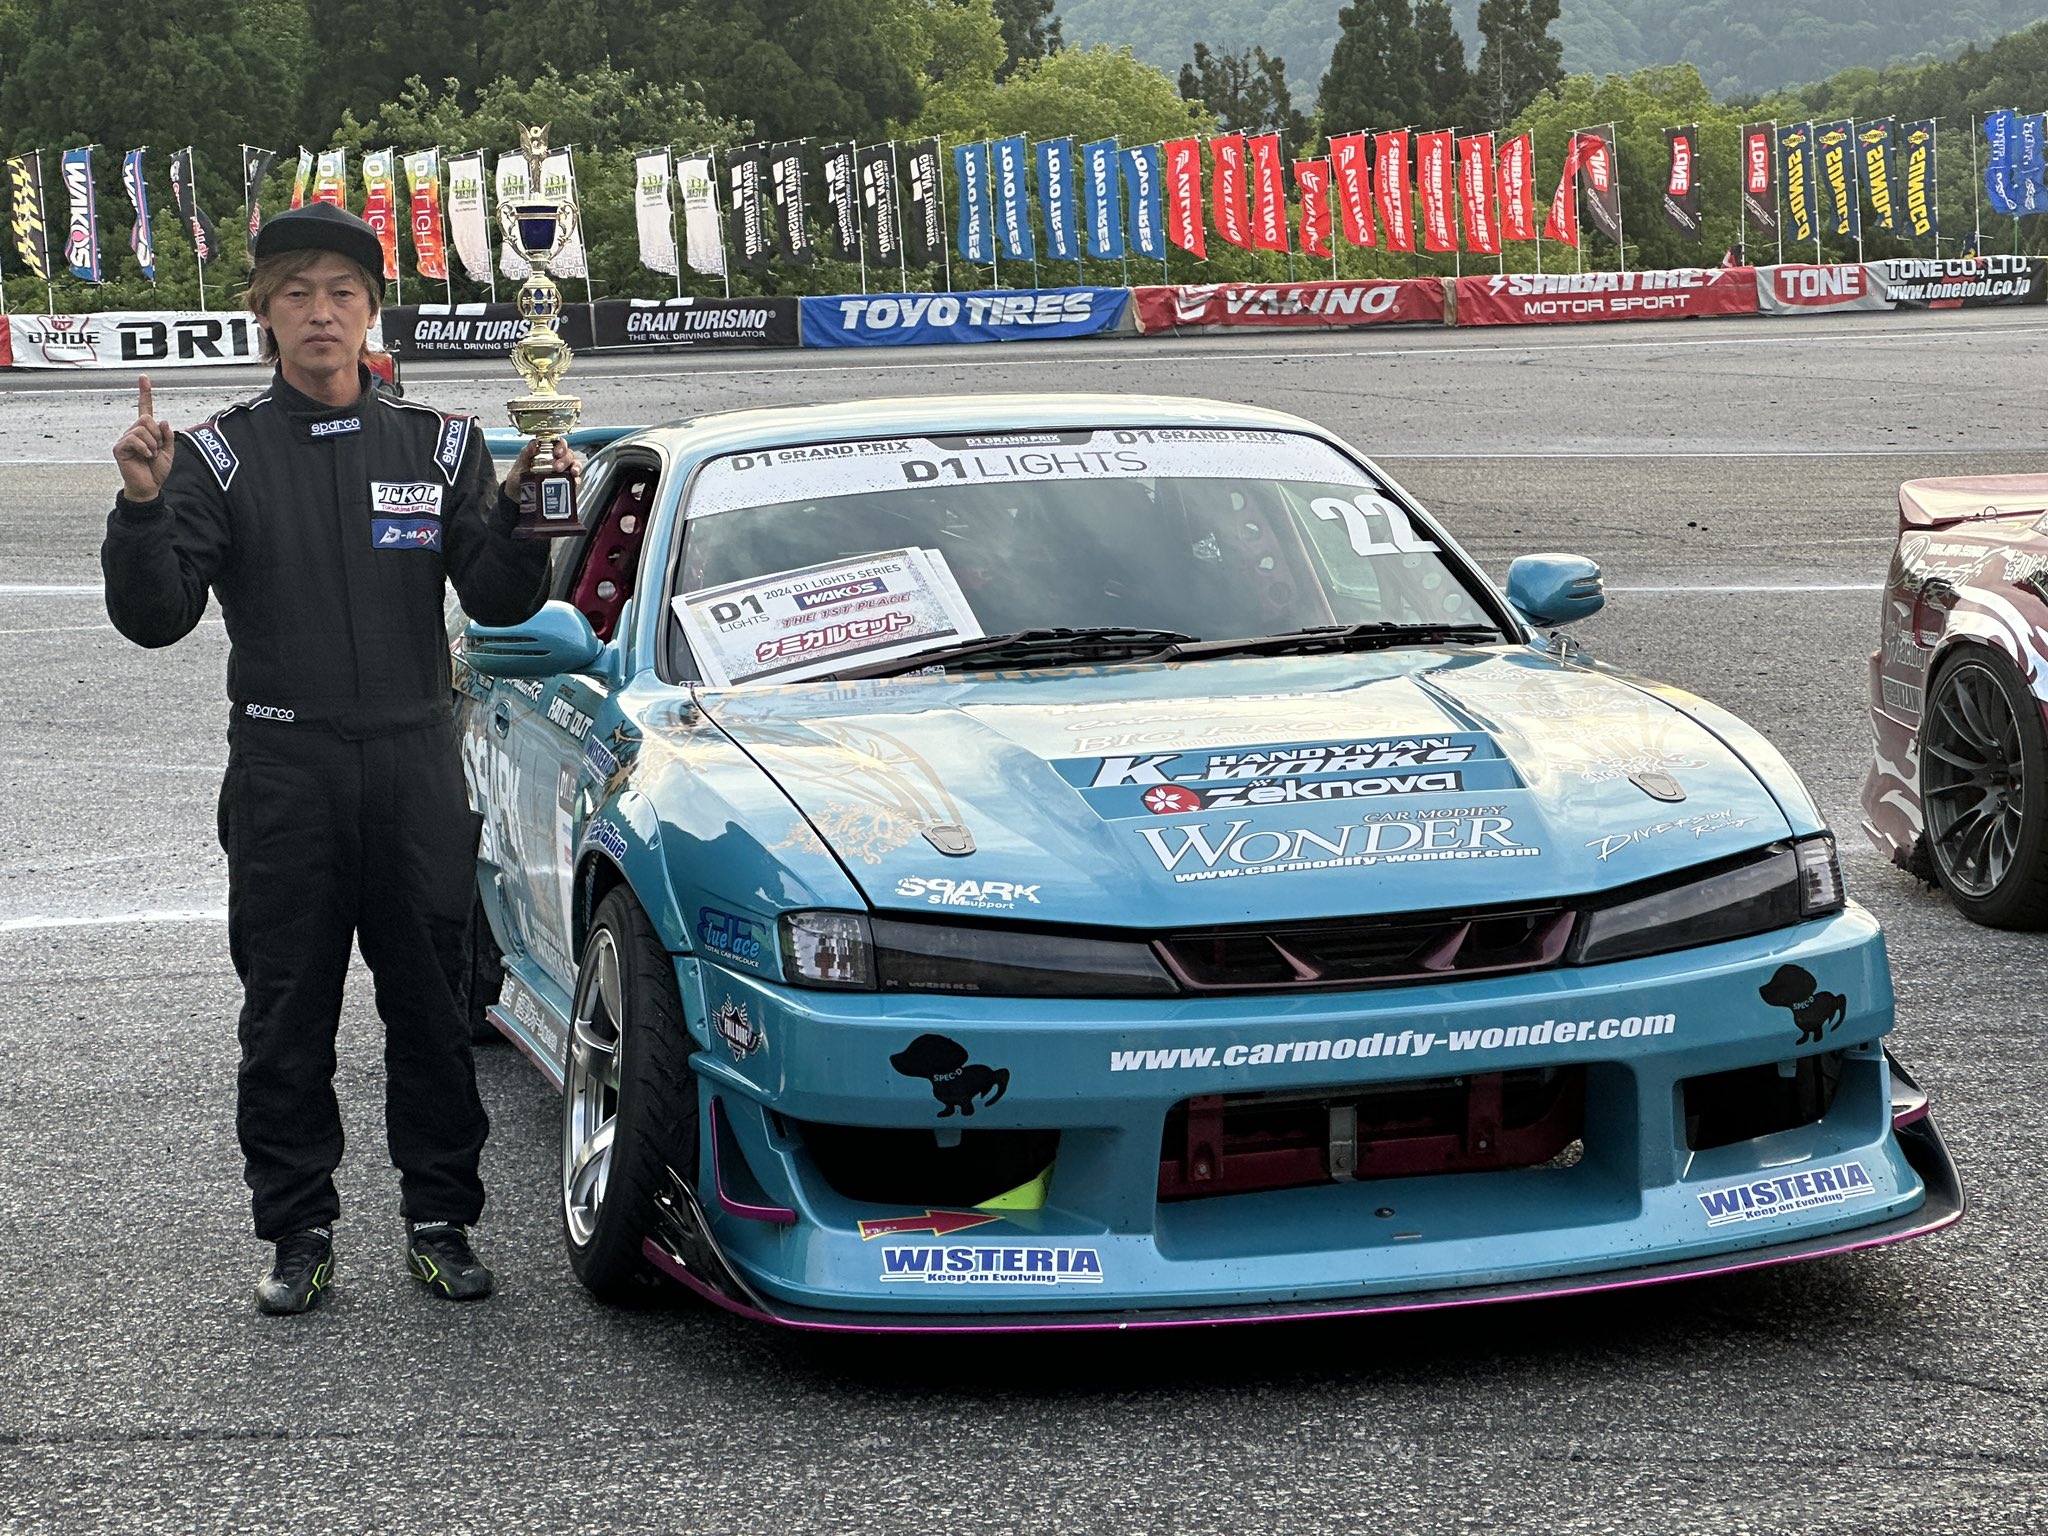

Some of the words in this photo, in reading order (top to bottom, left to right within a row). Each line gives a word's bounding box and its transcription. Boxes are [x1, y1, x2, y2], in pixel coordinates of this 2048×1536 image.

[1381, 155, 1389, 193] MOTOR
[1223, 170, 1242, 241] VALINO
[1388, 147, 1405, 242] SHIBATIRE
[1431, 147, 1448, 242] SHIBATIRE
[1471, 151, 1489, 243] SHIBATIRE
[64, 162, 91, 268] WAKO'S
[1781, 266, 1860, 299] TONE
[1886, 260, 1944, 280] TONE
[1885, 277, 2031, 301] www.tonetool.co.jp
[840, 297, 962, 330] TOYO
[966, 293, 1093, 326] TIRES
[1524, 299, 1604, 315] MOTOR
[1610, 294, 1690, 312] SPORT
[414, 320, 470, 341] GRAN
[475, 320, 560, 341] TURISO
[627, 312, 680, 332] GRAN
[684, 309, 767, 331] TURISMO
[673, 331, 710, 340] DRIVING
[712, 330, 766, 338] SIMULATOR
[28, 331, 101, 344] BRIDE
[116, 318, 261, 361] BRI
[416, 342, 435, 350] THE
[437, 342, 462, 350] REAL
[464, 342, 501, 350] DRIVING
[311, 417, 360, 433] sparco
[1113, 431, 1155, 444] D1
[1158, 430, 1230, 440] GRAND
[1232, 432, 1283, 441] PRIX
[198, 428, 231, 469] sparco
[442, 420, 460, 464] sparco
[732, 453, 773, 471] D1
[778, 445, 853, 461] GRAND
[857, 441, 911, 453] PRIX
[900, 457, 968, 483] D1
[974, 450, 1148, 477] LIGHTS
[379, 484, 438, 505] TKL
[1310, 494, 1442, 556] 22
[763, 586, 792, 600] 2024
[793, 582, 809, 593] D1
[811, 573, 856, 589] LIGHTS
[858, 564, 902, 580] SERIES
[803, 580, 879, 606] WAKO'S
[710, 594, 767, 625] D1
[719, 613, 770, 633] LIGHTS
[781, 611, 816, 628] THE
[821, 604, 852, 622] 1ST
[856, 592, 912, 611] PLACE
[757, 613, 913, 663] ケミカルセット
[246, 703, 295, 721] sparco
[1209, 737, 1451, 766] HANDYMAN
[1363, 811, 1409, 823] CAR
[1417, 805, 1507, 820] MODIFY
[1174, 847, 1539, 883] www.carmodify-wonder.com
[703, 944, 721, 956] TOTAL
[720, 950, 732, 960] CAR
[1110, 1013, 1676, 1072] www.carmodify-wonder.com
[1700, 1164, 1870, 1218] WISTERIA
[1745, 1205, 1776, 1220] Keep
[1779, 1202, 1794, 1212] on
[1796, 1192, 1843, 1211] Evolving
[884, 1249, 1102, 1274] WISTERIA
[927, 1273, 967, 1283] Keep
[969, 1274, 988, 1282] on
[992, 1273, 1056, 1284] Evolving
